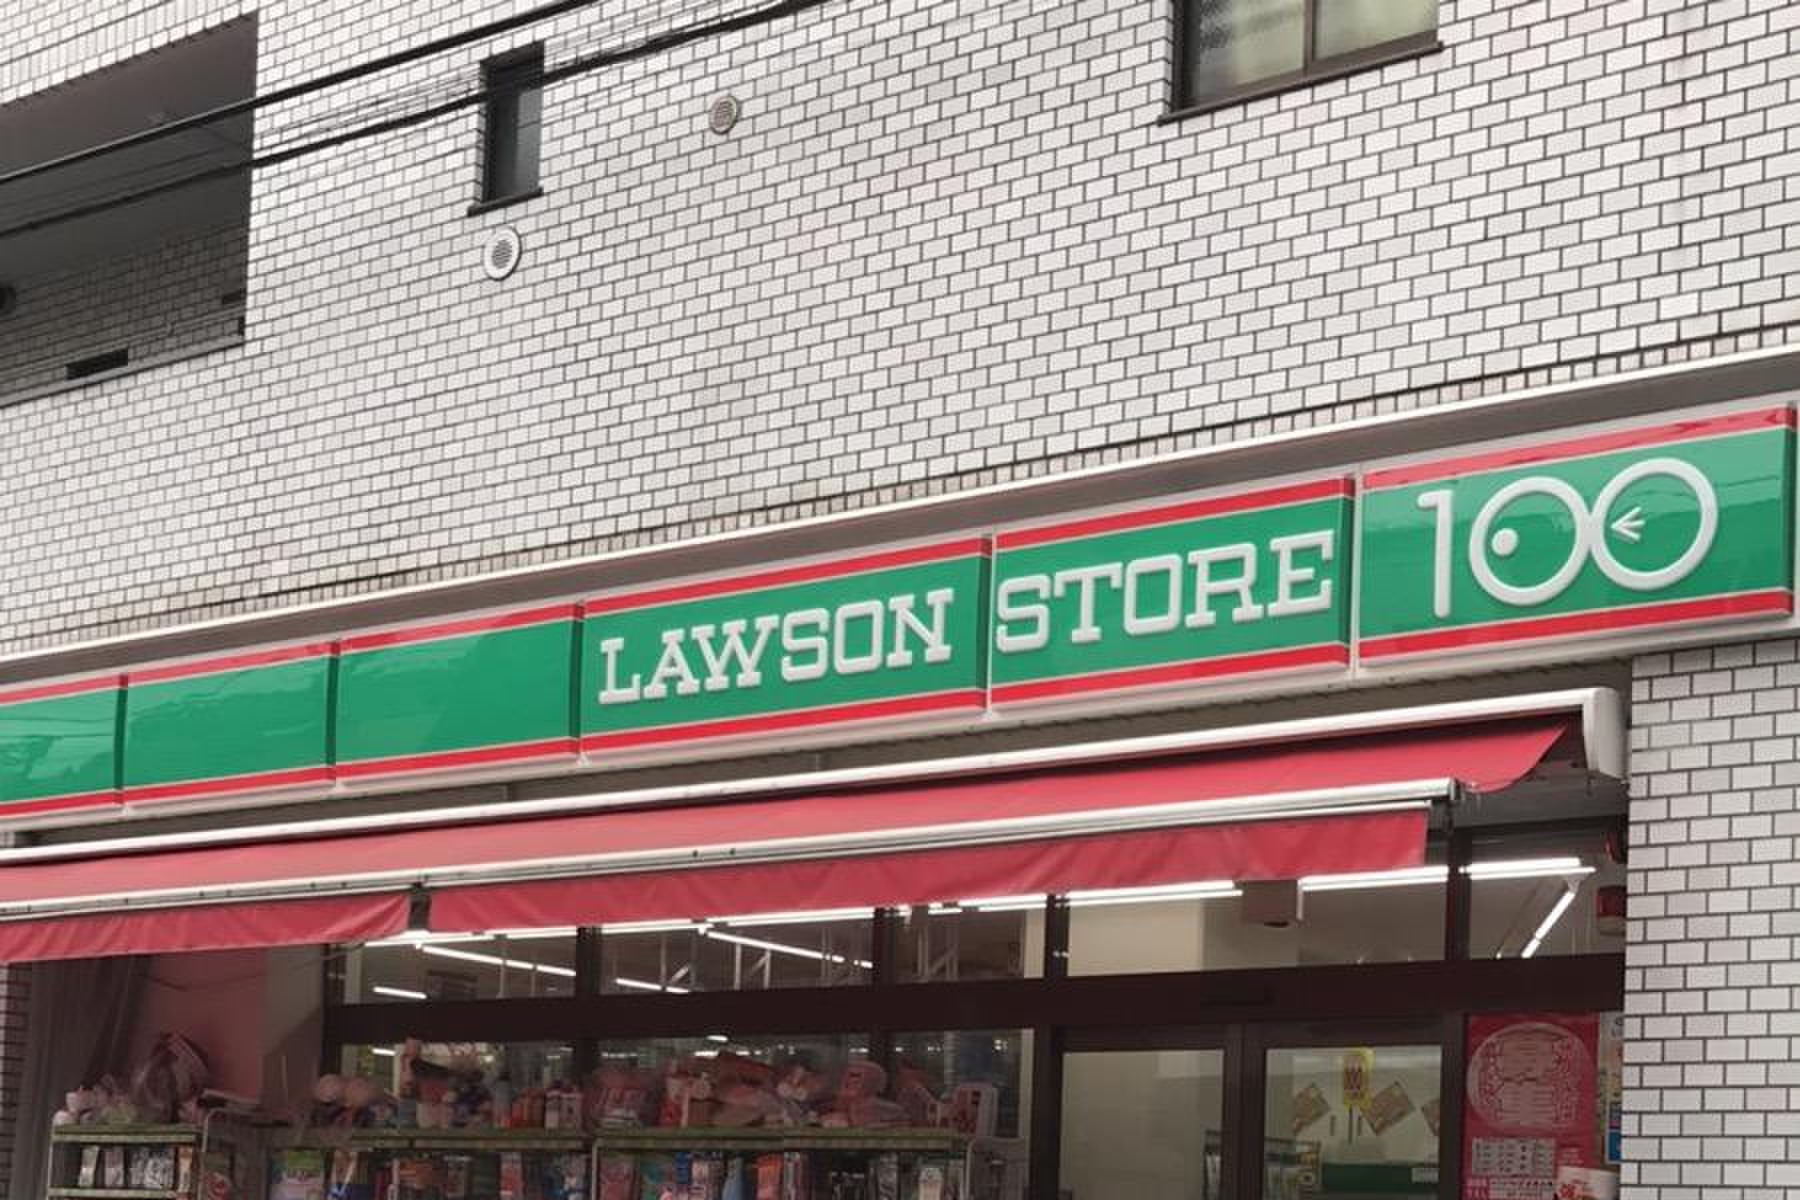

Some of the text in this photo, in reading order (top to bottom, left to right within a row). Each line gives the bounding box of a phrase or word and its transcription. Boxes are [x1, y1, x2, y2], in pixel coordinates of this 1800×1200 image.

[599, 456, 1720, 705] LAWSON STORE 100
